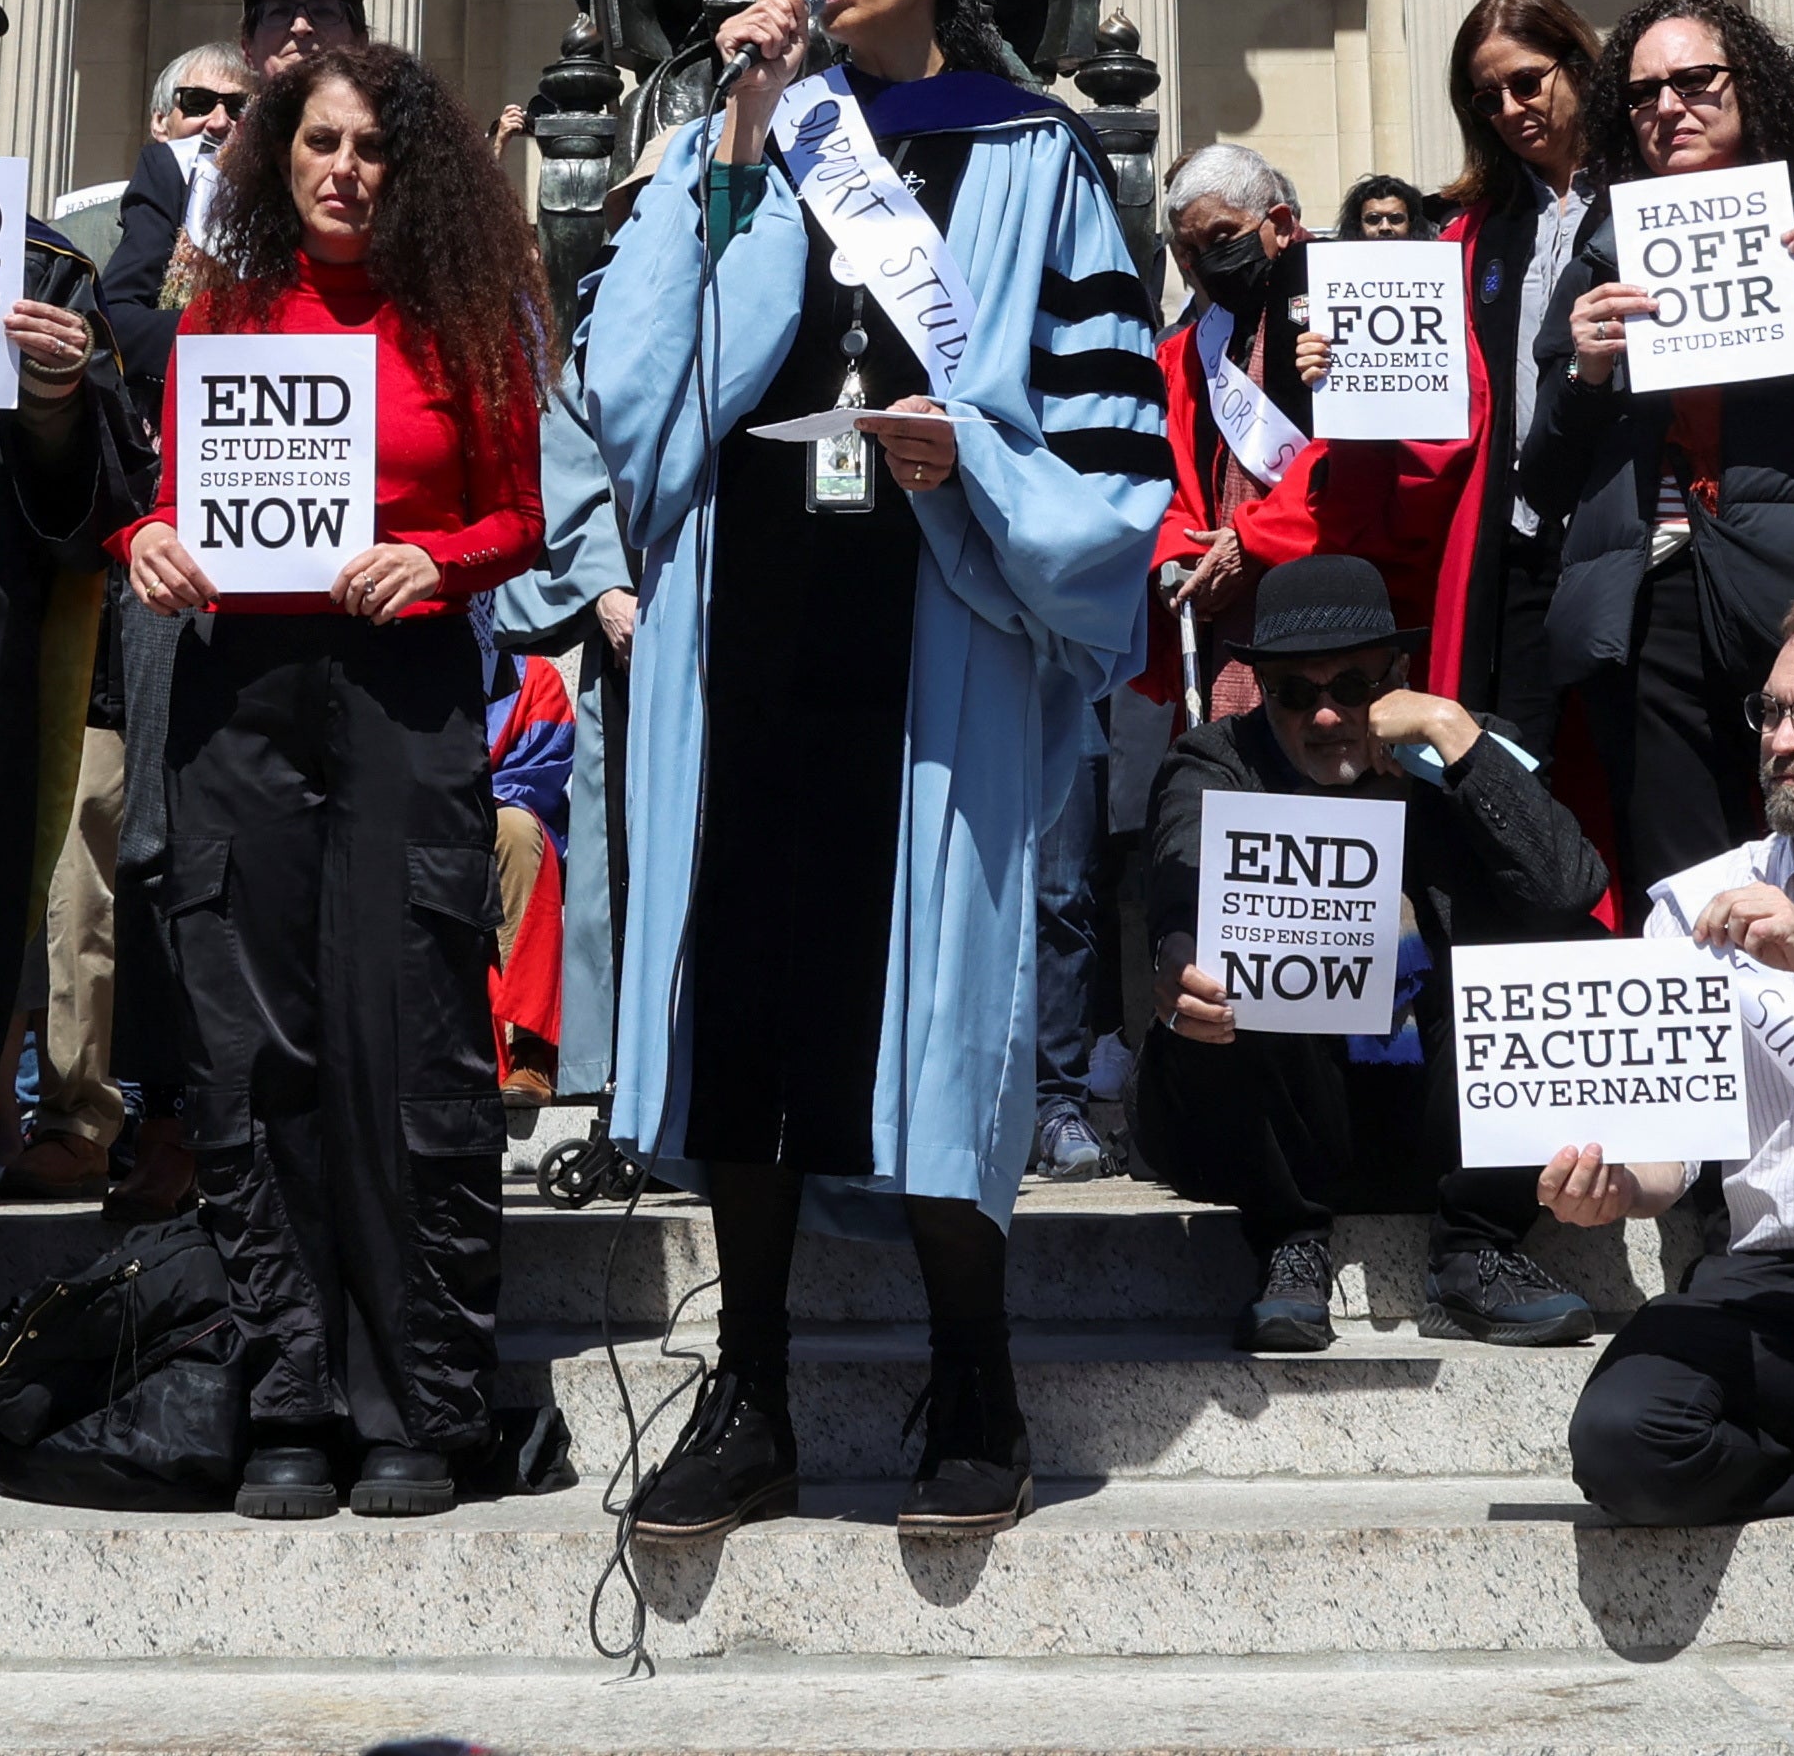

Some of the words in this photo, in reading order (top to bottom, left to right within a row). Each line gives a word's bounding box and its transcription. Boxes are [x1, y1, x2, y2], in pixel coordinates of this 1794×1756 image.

[1638, 191, 1768, 231] HANDS
[1641, 225, 1772, 278] OFF
[1327, 282, 1445, 299] FACULTY
[1648, 276, 1780, 328] OUR
[1328, 305, 1447, 346] FOR
[1652, 322, 1786, 356] STUDENTS
[1330, 352, 1448, 368] ACADEMIC
[201, 374, 351, 428] END
[1330, 375, 1449, 392] FREEDOM
[200, 437, 351, 462] STUDENT
[200, 470, 351, 488] SUSPENSIONS
[200, 497, 350, 548] NOW
[1223, 831, 1379, 889] END
[1221, 892, 1377, 922] STUDENT
[1221, 924, 1376, 946] SUSPENSIONS
[1221, 952, 1373, 1000] NOW
[1462, 975, 1732, 1023] RESTORE
[1465, 1024, 1730, 1072] FACULTY
[1466, 1074, 1737, 1110] GOVERNANCE
